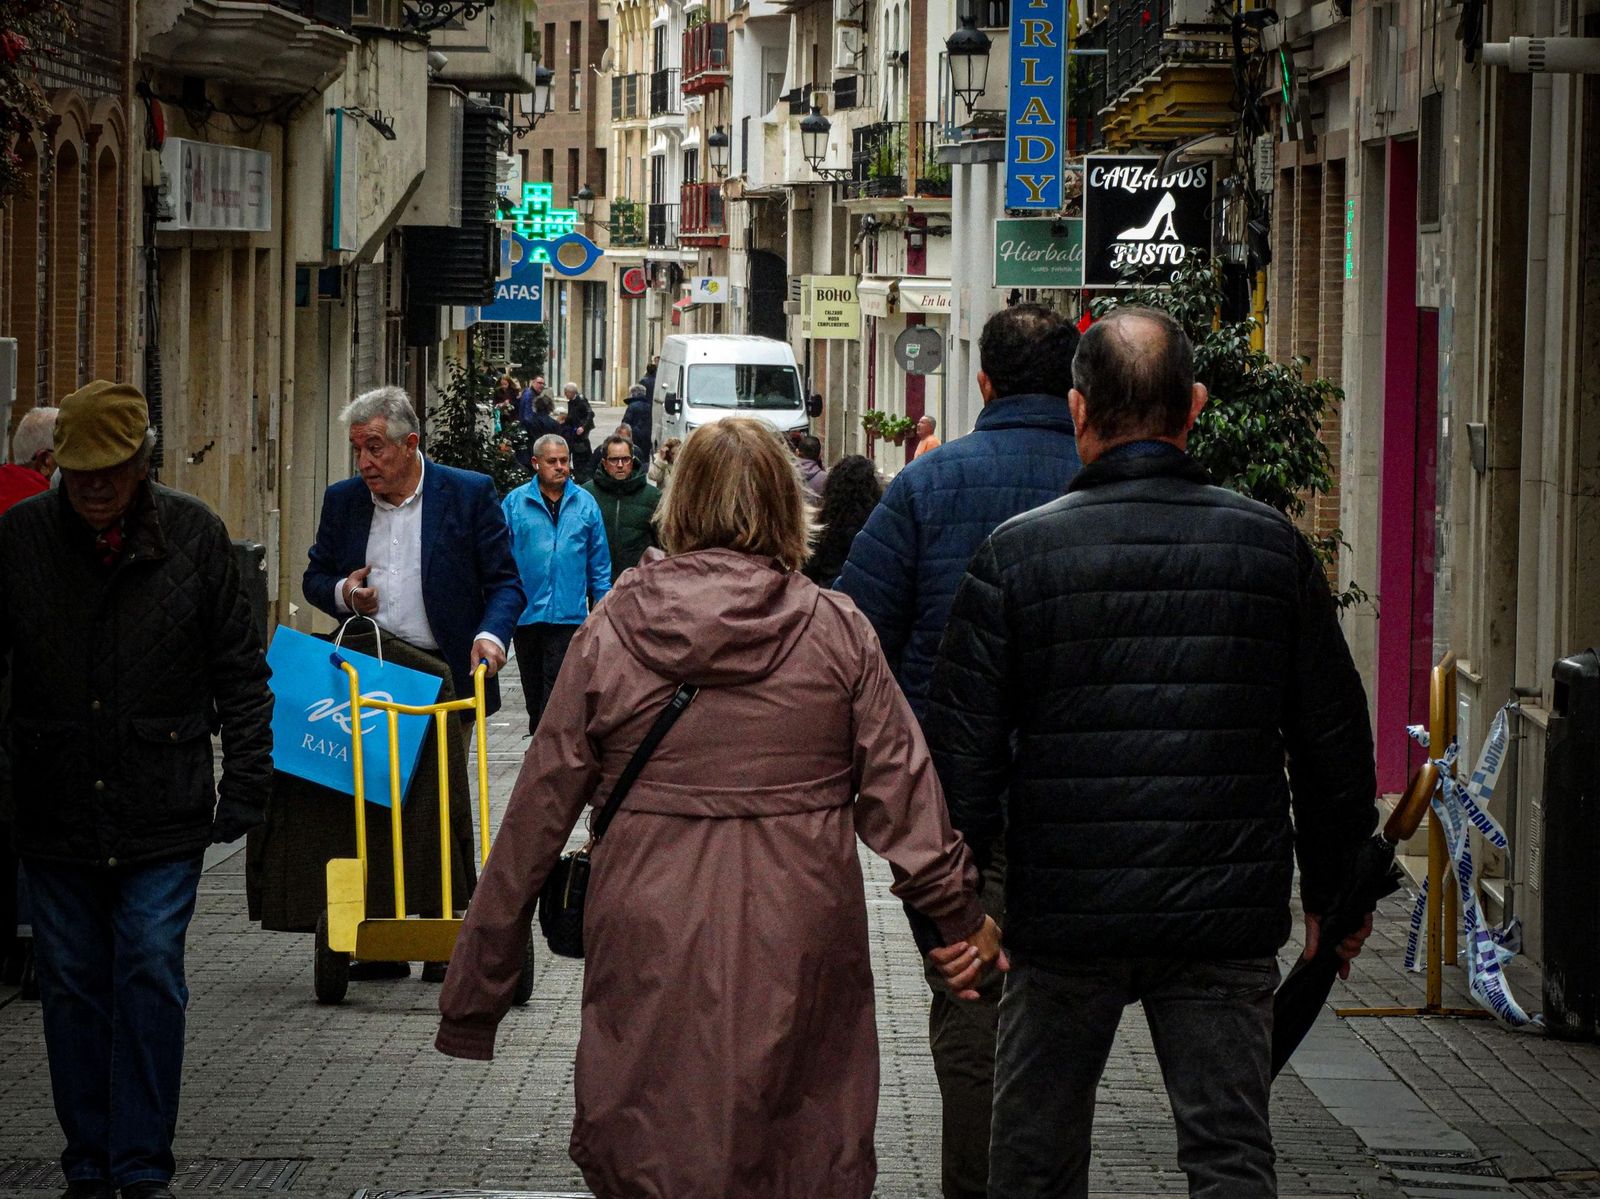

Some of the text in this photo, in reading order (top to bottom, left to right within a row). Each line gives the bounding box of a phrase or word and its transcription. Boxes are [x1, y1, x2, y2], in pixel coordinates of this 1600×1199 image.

[1015, 0, 1056, 202] RLADY
[1110, 243, 1185, 269] JUSTO
[494, 285, 540, 301] AFAS
[816, 289, 851, 303] BOHO
[920, 295, 934, 307] En
[936, 295, 946, 307] la
[301, 732, 348, 762] RAYA
